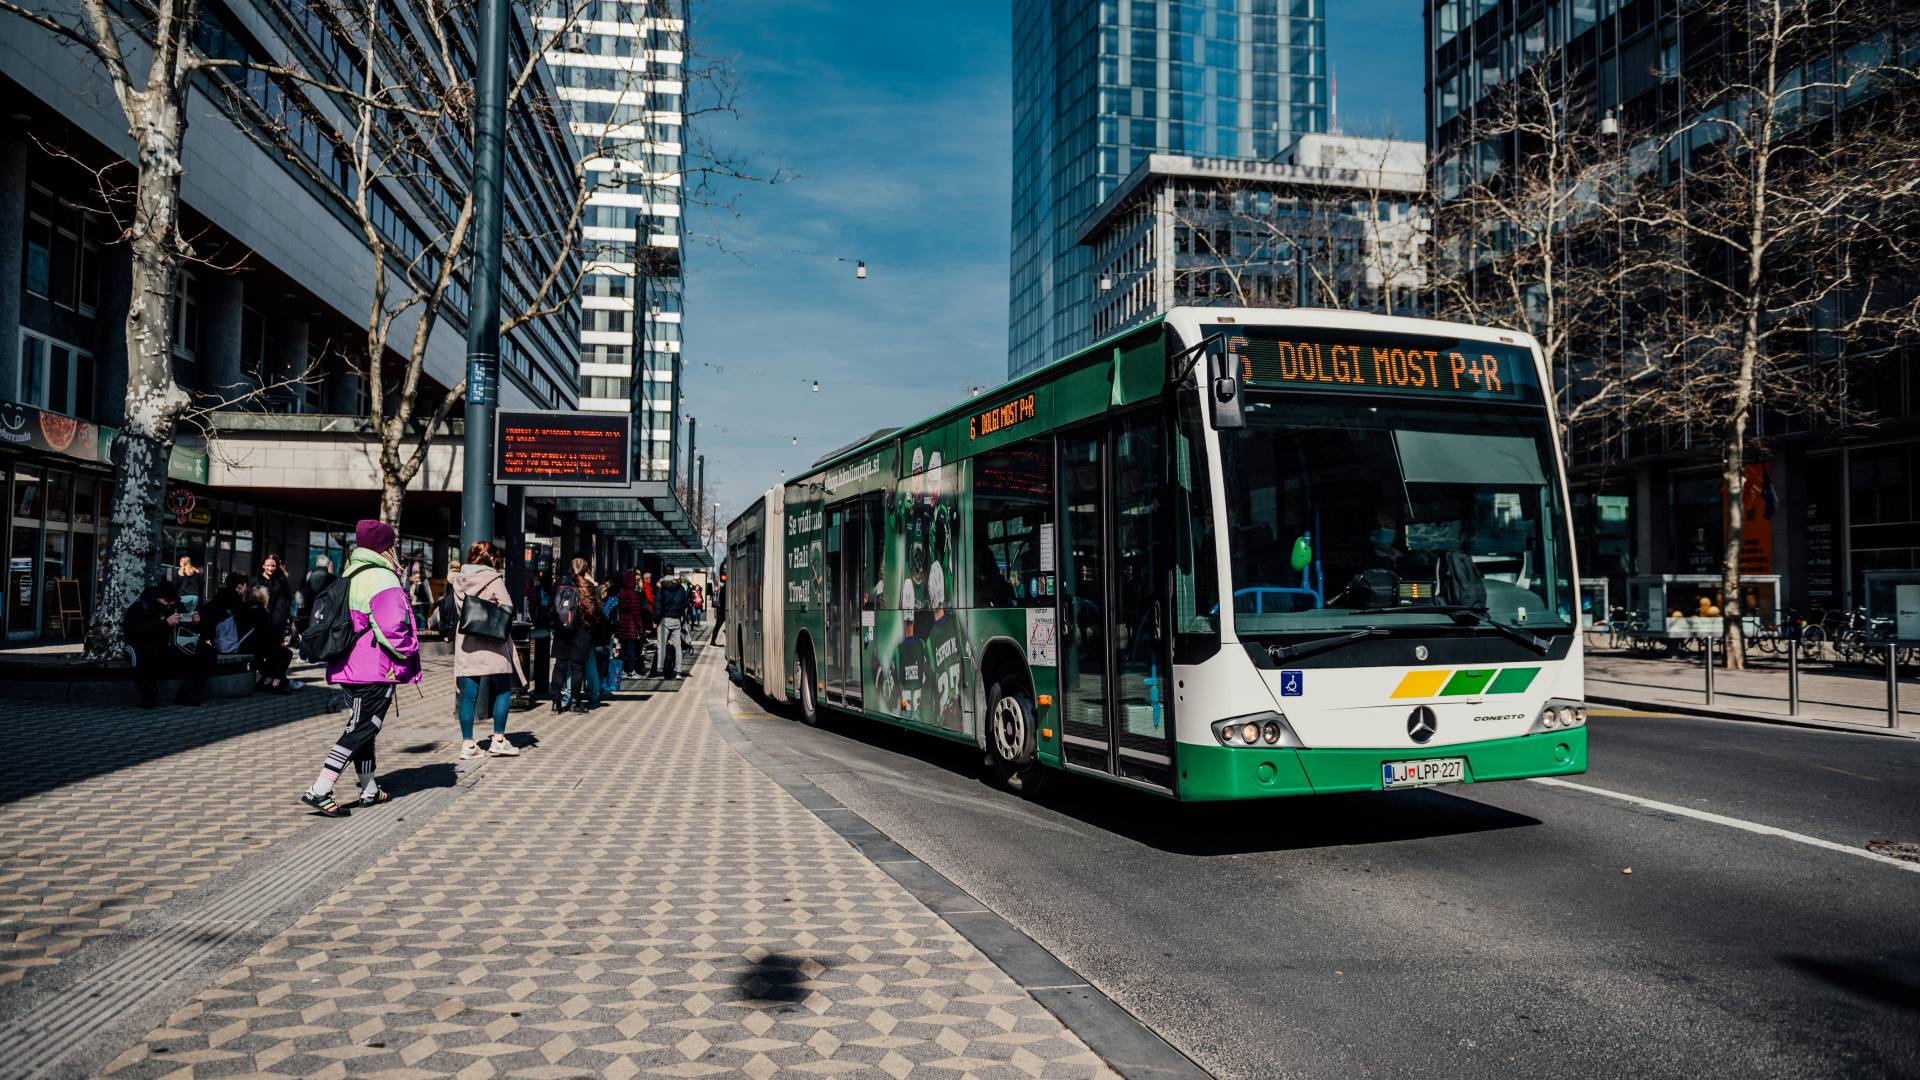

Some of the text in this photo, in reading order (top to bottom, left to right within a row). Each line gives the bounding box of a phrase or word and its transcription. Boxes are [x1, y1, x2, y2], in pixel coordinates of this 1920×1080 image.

[1278, 341, 1365, 384] DOLGI
[1372, 346, 1438, 388] MOST
[1449, 352, 1502, 391] P+R
[970, 394, 1034, 440] 6 DOLGI MOST P+R
[788, 508, 823, 536] Se vidimo
[788, 544, 809, 569] v Hali
[1473, 713, 1525, 722] CONECTO
[1392, 765, 1408, 782] LJ
